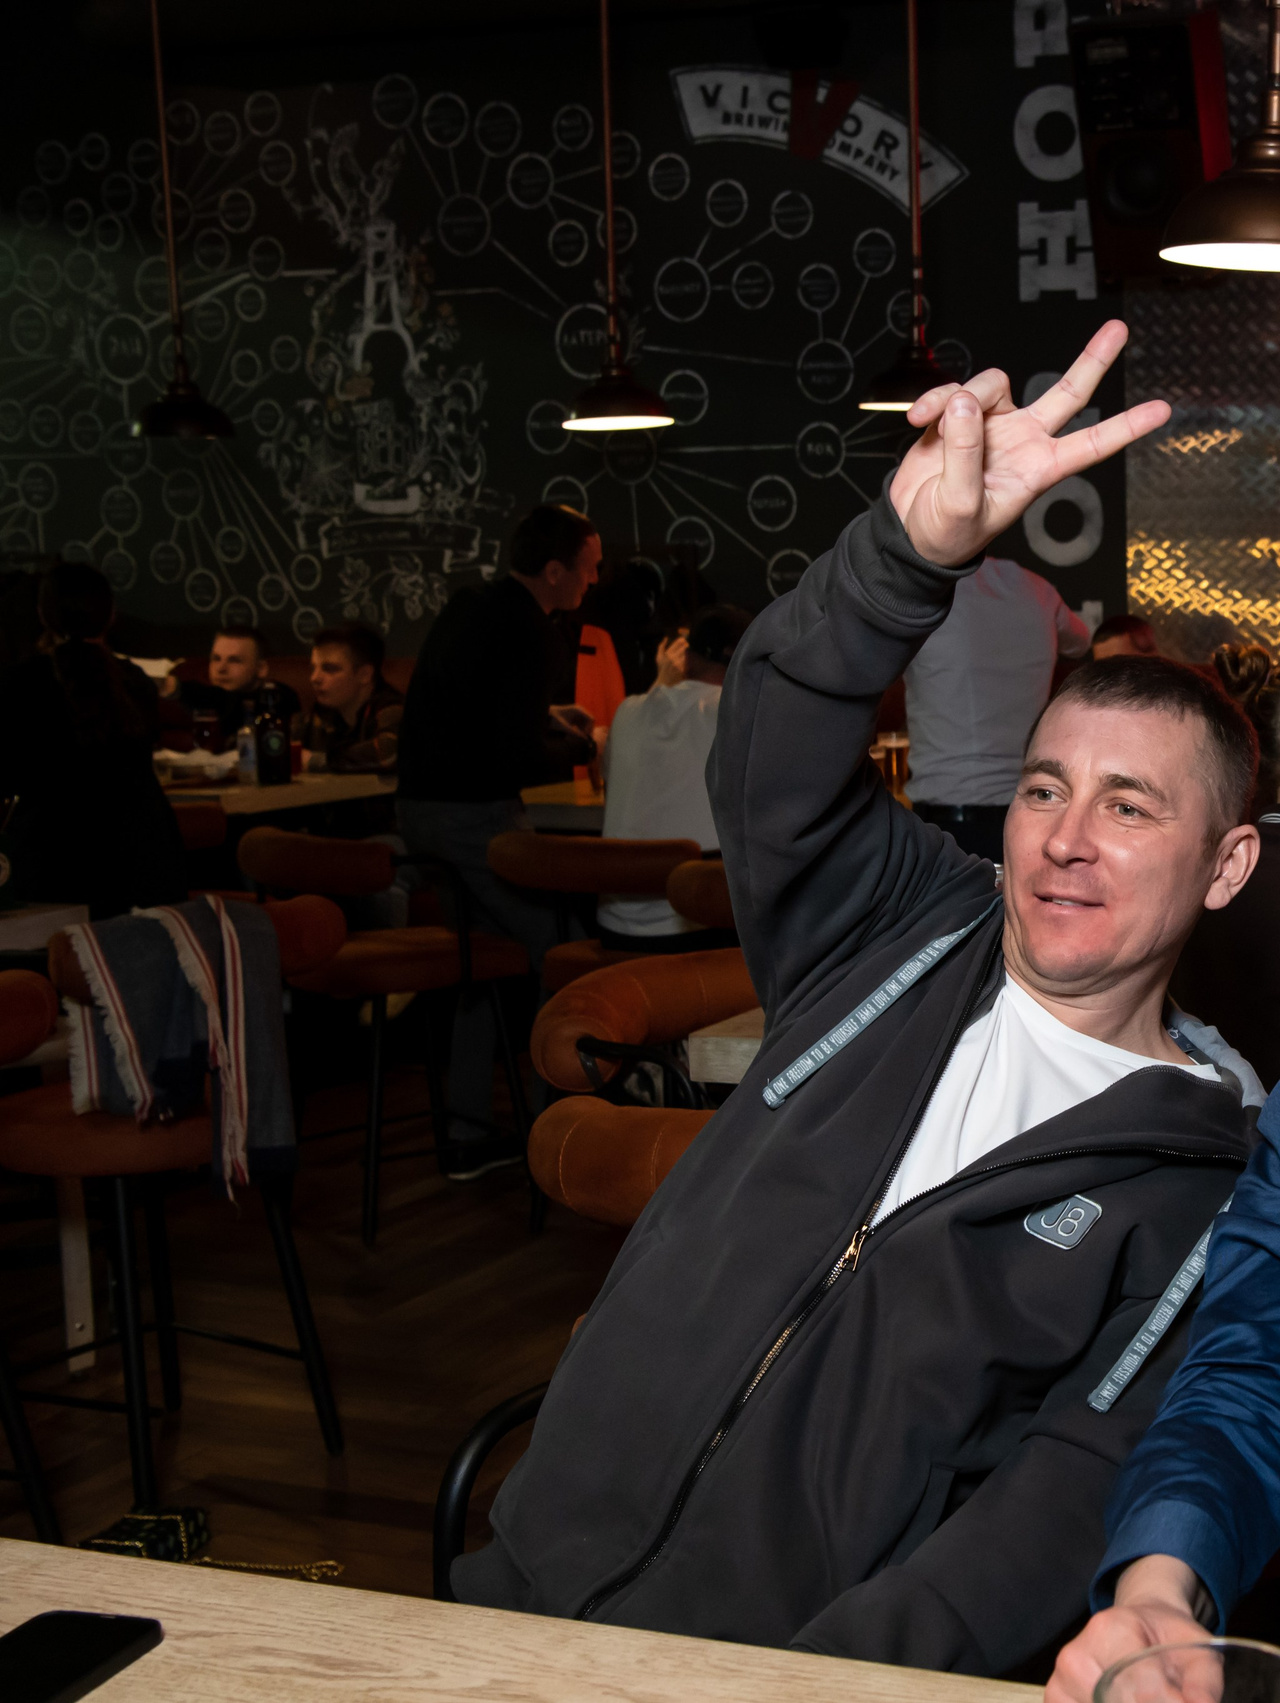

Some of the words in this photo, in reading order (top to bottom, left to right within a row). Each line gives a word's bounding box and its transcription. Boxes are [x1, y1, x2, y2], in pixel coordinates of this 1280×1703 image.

[700, 84, 933, 171] VICOR
[826, 137, 899, 182] OMPANY
[773, 1077, 789, 1094] ONE
[786, 1055, 816, 1083] FREEDOM
[810, 1048, 825, 1062] TO
[819, 1040, 834, 1055] BE
[828, 1018, 861, 1047] YOURSELF
[871, 990, 891, 1009] LOVE
[897, 958, 926, 986] FREEDOM
[918, 952, 933, 964] TO
[1167, 1287, 1185, 1305] ONE
[1176, 1272, 1196, 1297] LOVE
[1148, 1302, 1176, 1335] FREEDOM
[1133, 1341, 1148, 1356] BE
[1141, 1332, 1155, 1346] TO
[1111, 1353, 1141, 1385] YOURSELF
